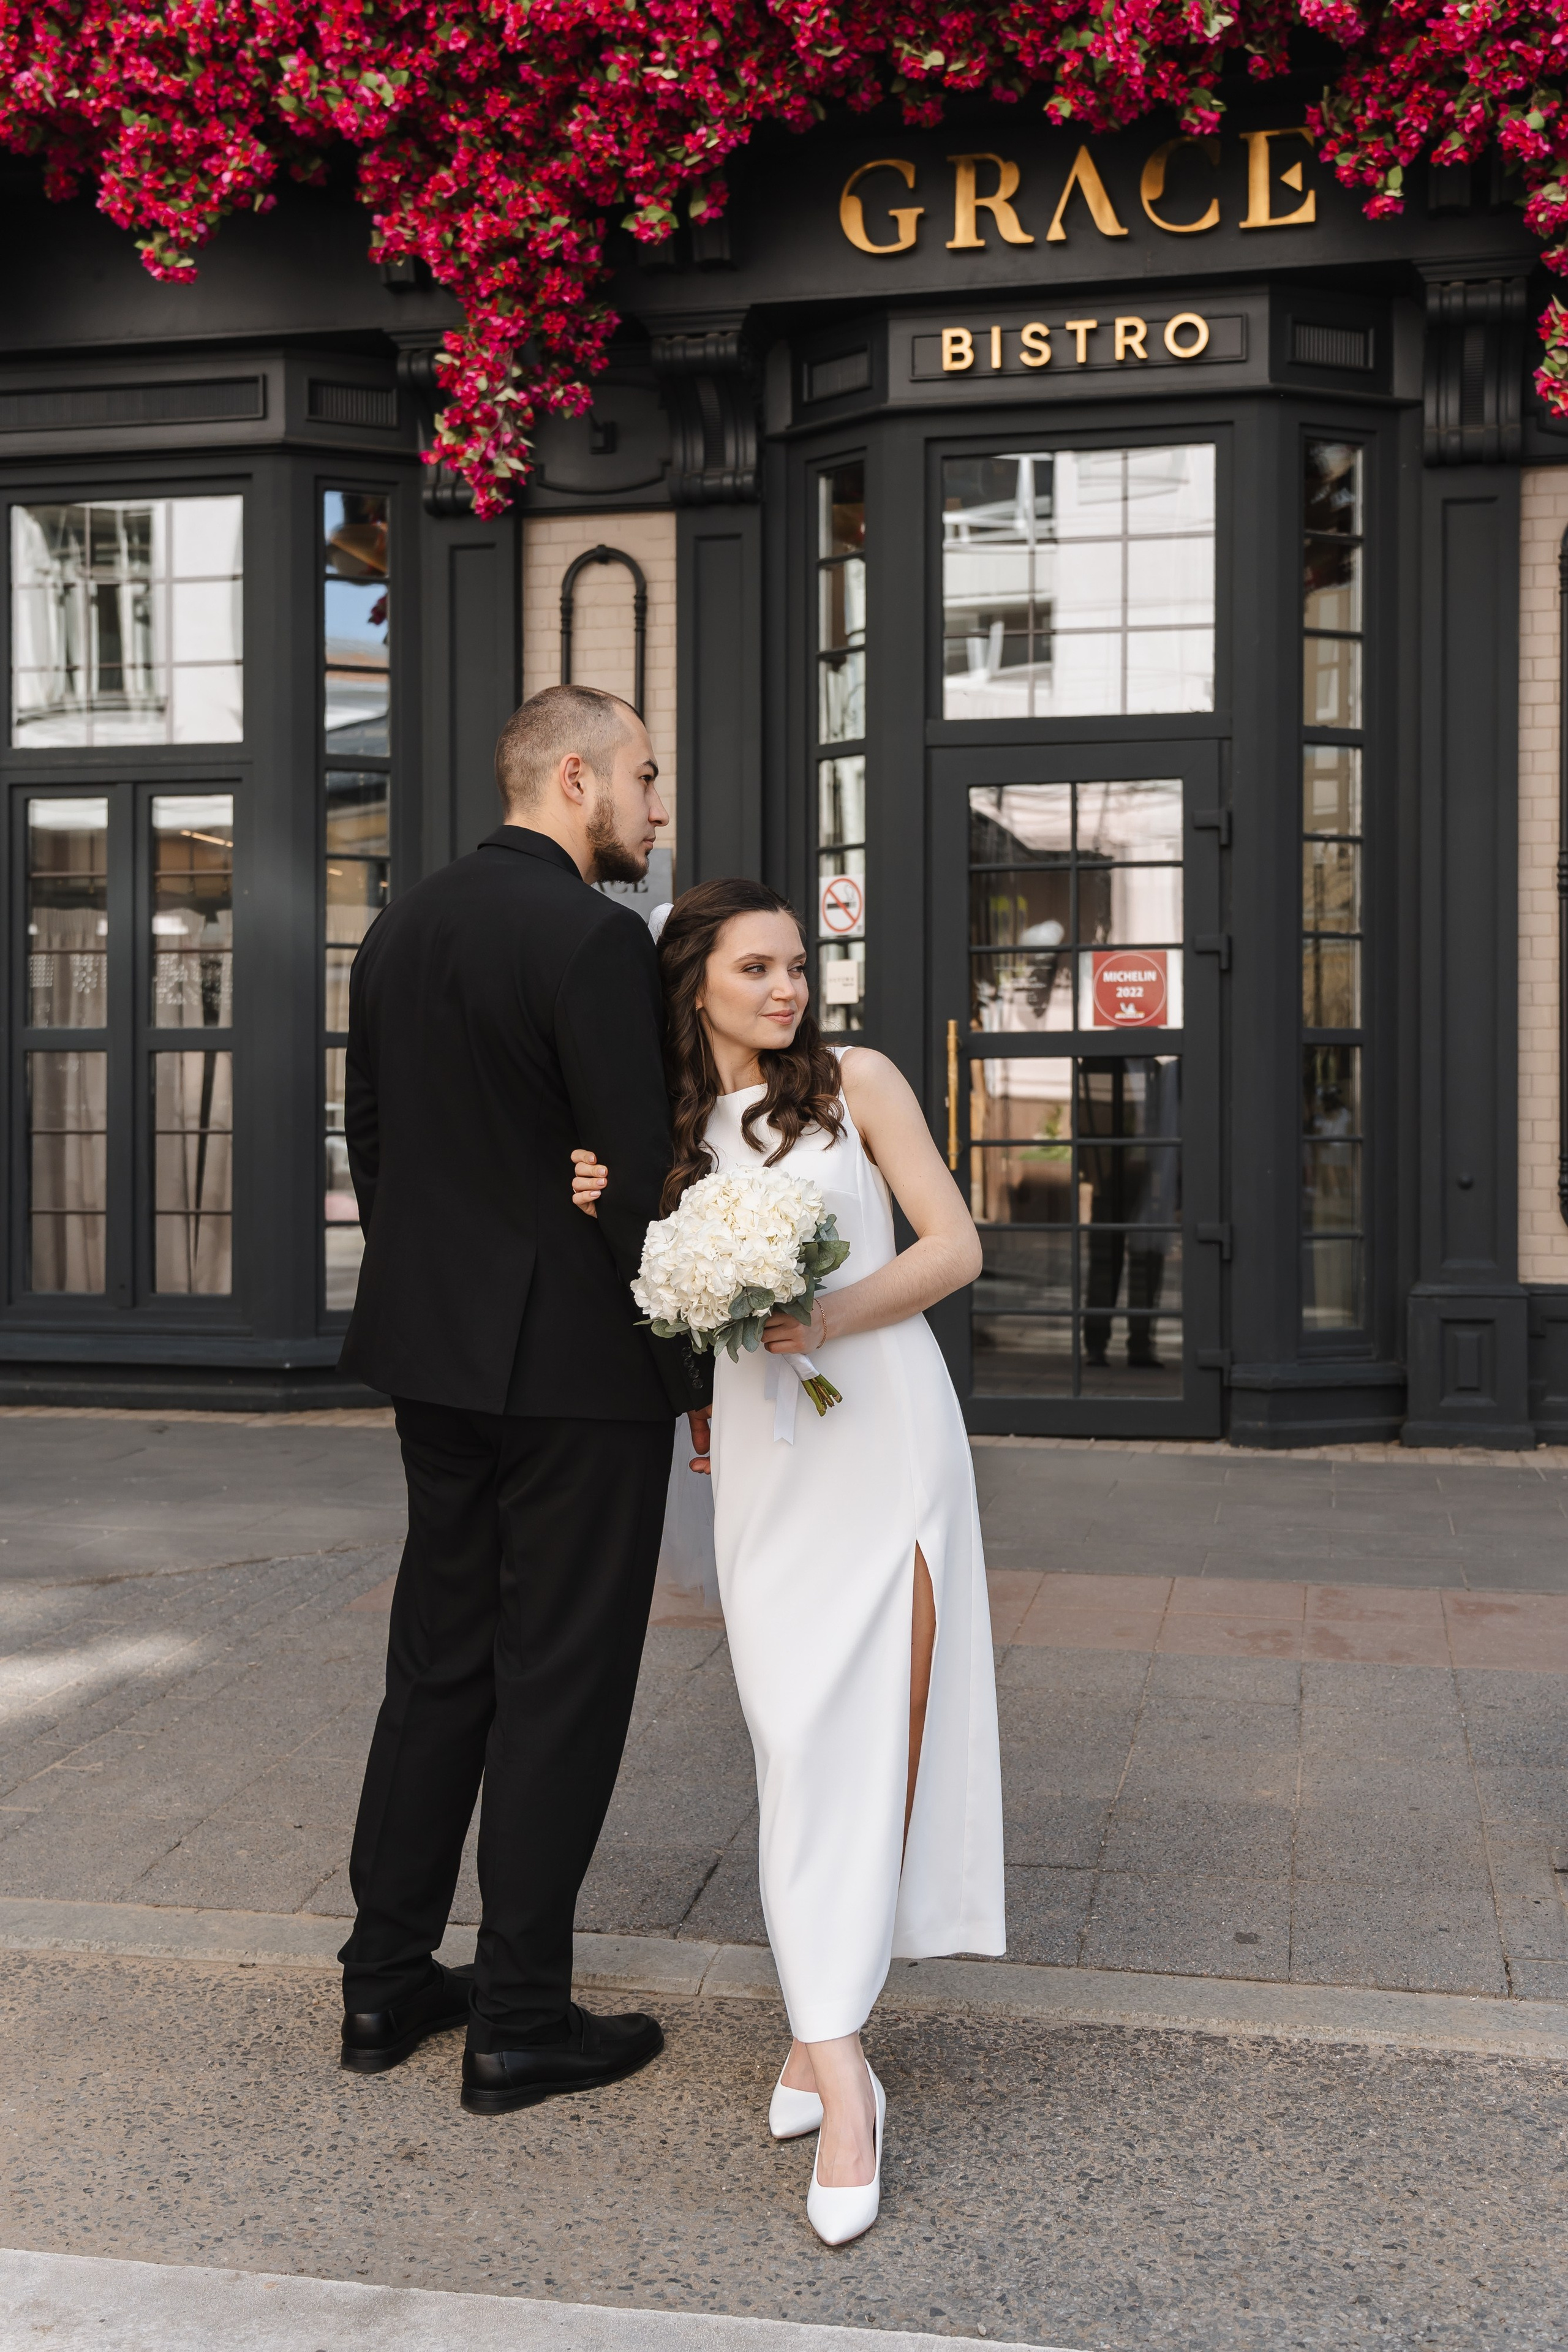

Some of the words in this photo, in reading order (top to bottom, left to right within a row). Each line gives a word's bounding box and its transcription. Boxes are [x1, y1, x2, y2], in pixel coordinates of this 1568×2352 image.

[840, 127, 1316, 254] GRACE
[941, 312, 1210, 371] BISTRO
[1103, 971, 1156, 982] MICHELIN
[1116, 986, 1144, 998] 2022
